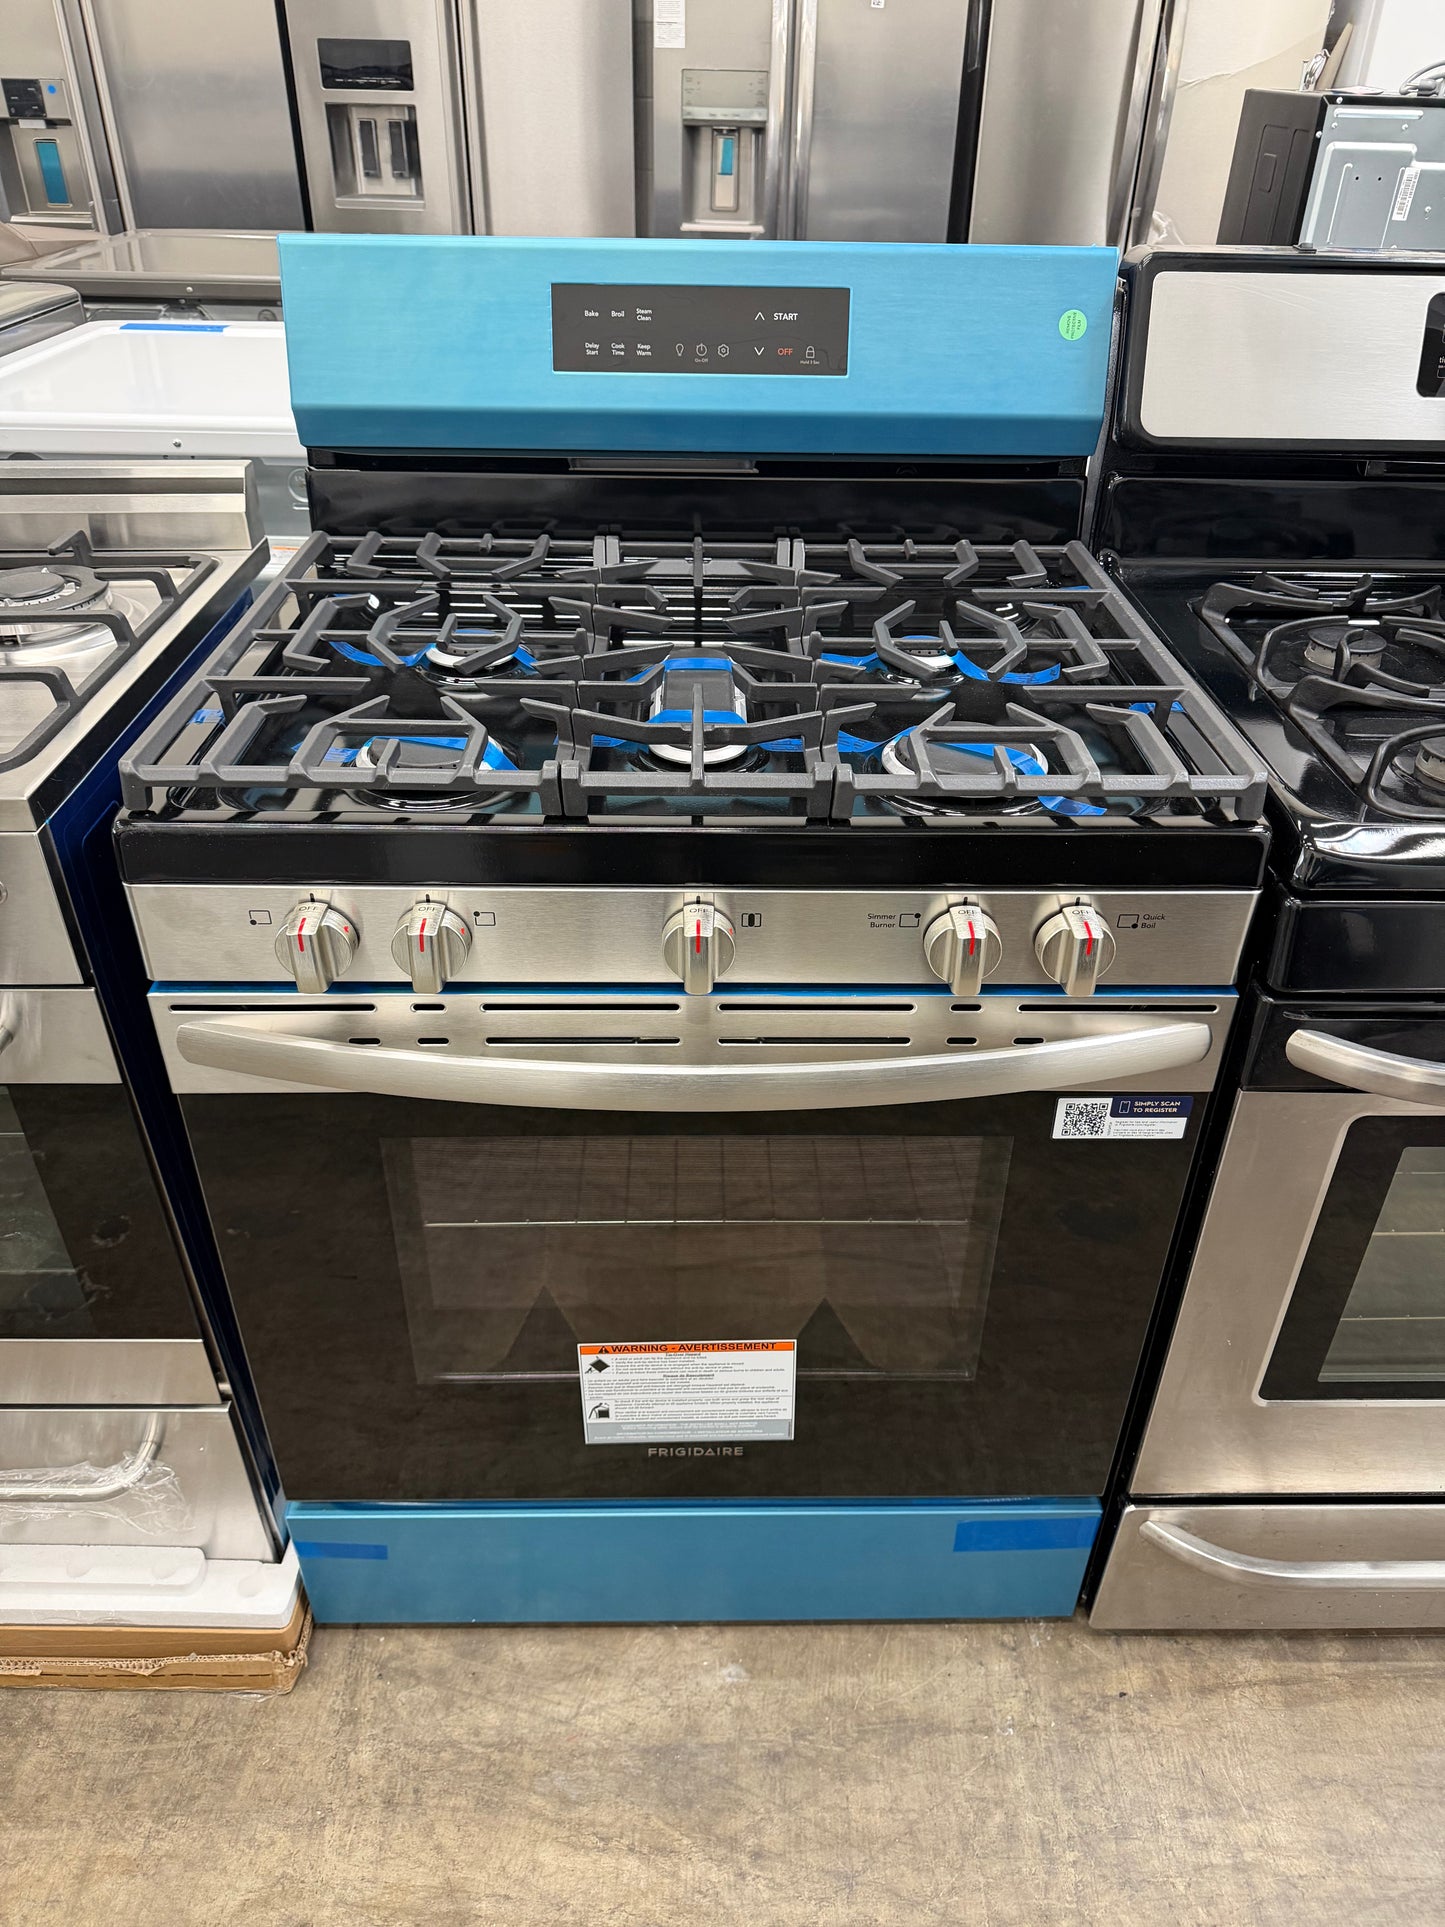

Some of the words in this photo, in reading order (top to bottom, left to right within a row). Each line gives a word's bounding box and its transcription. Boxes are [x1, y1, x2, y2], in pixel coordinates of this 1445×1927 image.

[773, 312, 798, 321] START
[585, 342, 600, 350] Delay
[777, 347, 793, 356] OFF
[611, 1344, 668, 1353] WARNING
[678, 1342, 777, 1352] AVERTISSEMENT
[647, 1446, 744, 1457] FRIGIDAIRE
